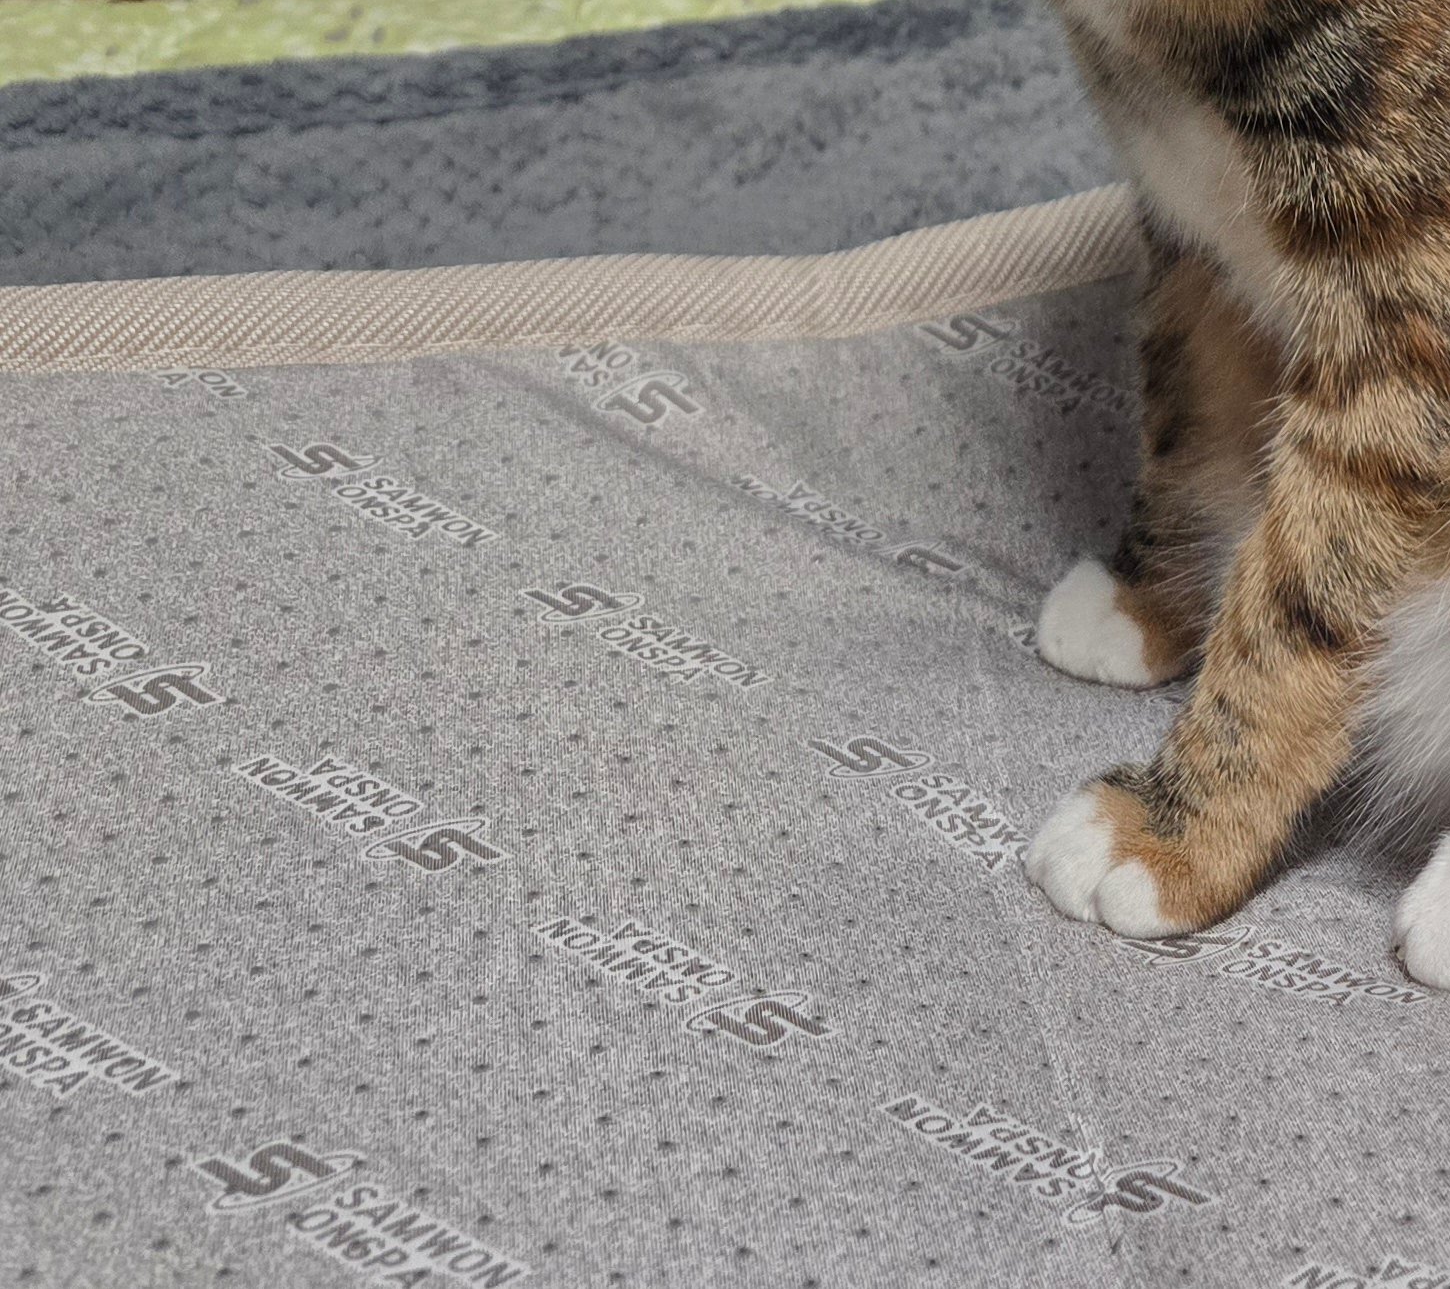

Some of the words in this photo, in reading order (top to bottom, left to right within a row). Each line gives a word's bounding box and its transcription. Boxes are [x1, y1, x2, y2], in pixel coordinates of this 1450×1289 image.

[338, 485, 432, 539] ONSPA
[367, 478, 493, 543] SAMWON
[788, 483, 883, 541] ONSPA
[43, 597, 146, 659] ONSPA
[600, 627, 700, 679] ONSPA
[629, 615, 767, 685] SAMWON
[244, 759, 386, 833] SAMWON
[310, 759, 419, 817] ONSPA
[896, 783, 1006, 868] ONSPA
[543, 921, 689, 1004] SAMWON
[612, 923, 735, 987] ONSPA
[1220, 958, 1352, 1005] ONSPA
[1250, 941, 1425, 1005] SAMWON
[0, 1026, 89, 1093] NSPA
[12, 1003, 169, 1090] SAMWON
[889, 1097, 1076, 1198] SAMWON
[970, 1106, 1097, 1180] ONSPA
[298, 1208, 432, 1289] ONSPA
[336, 1186, 521, 1288] SAMWON
